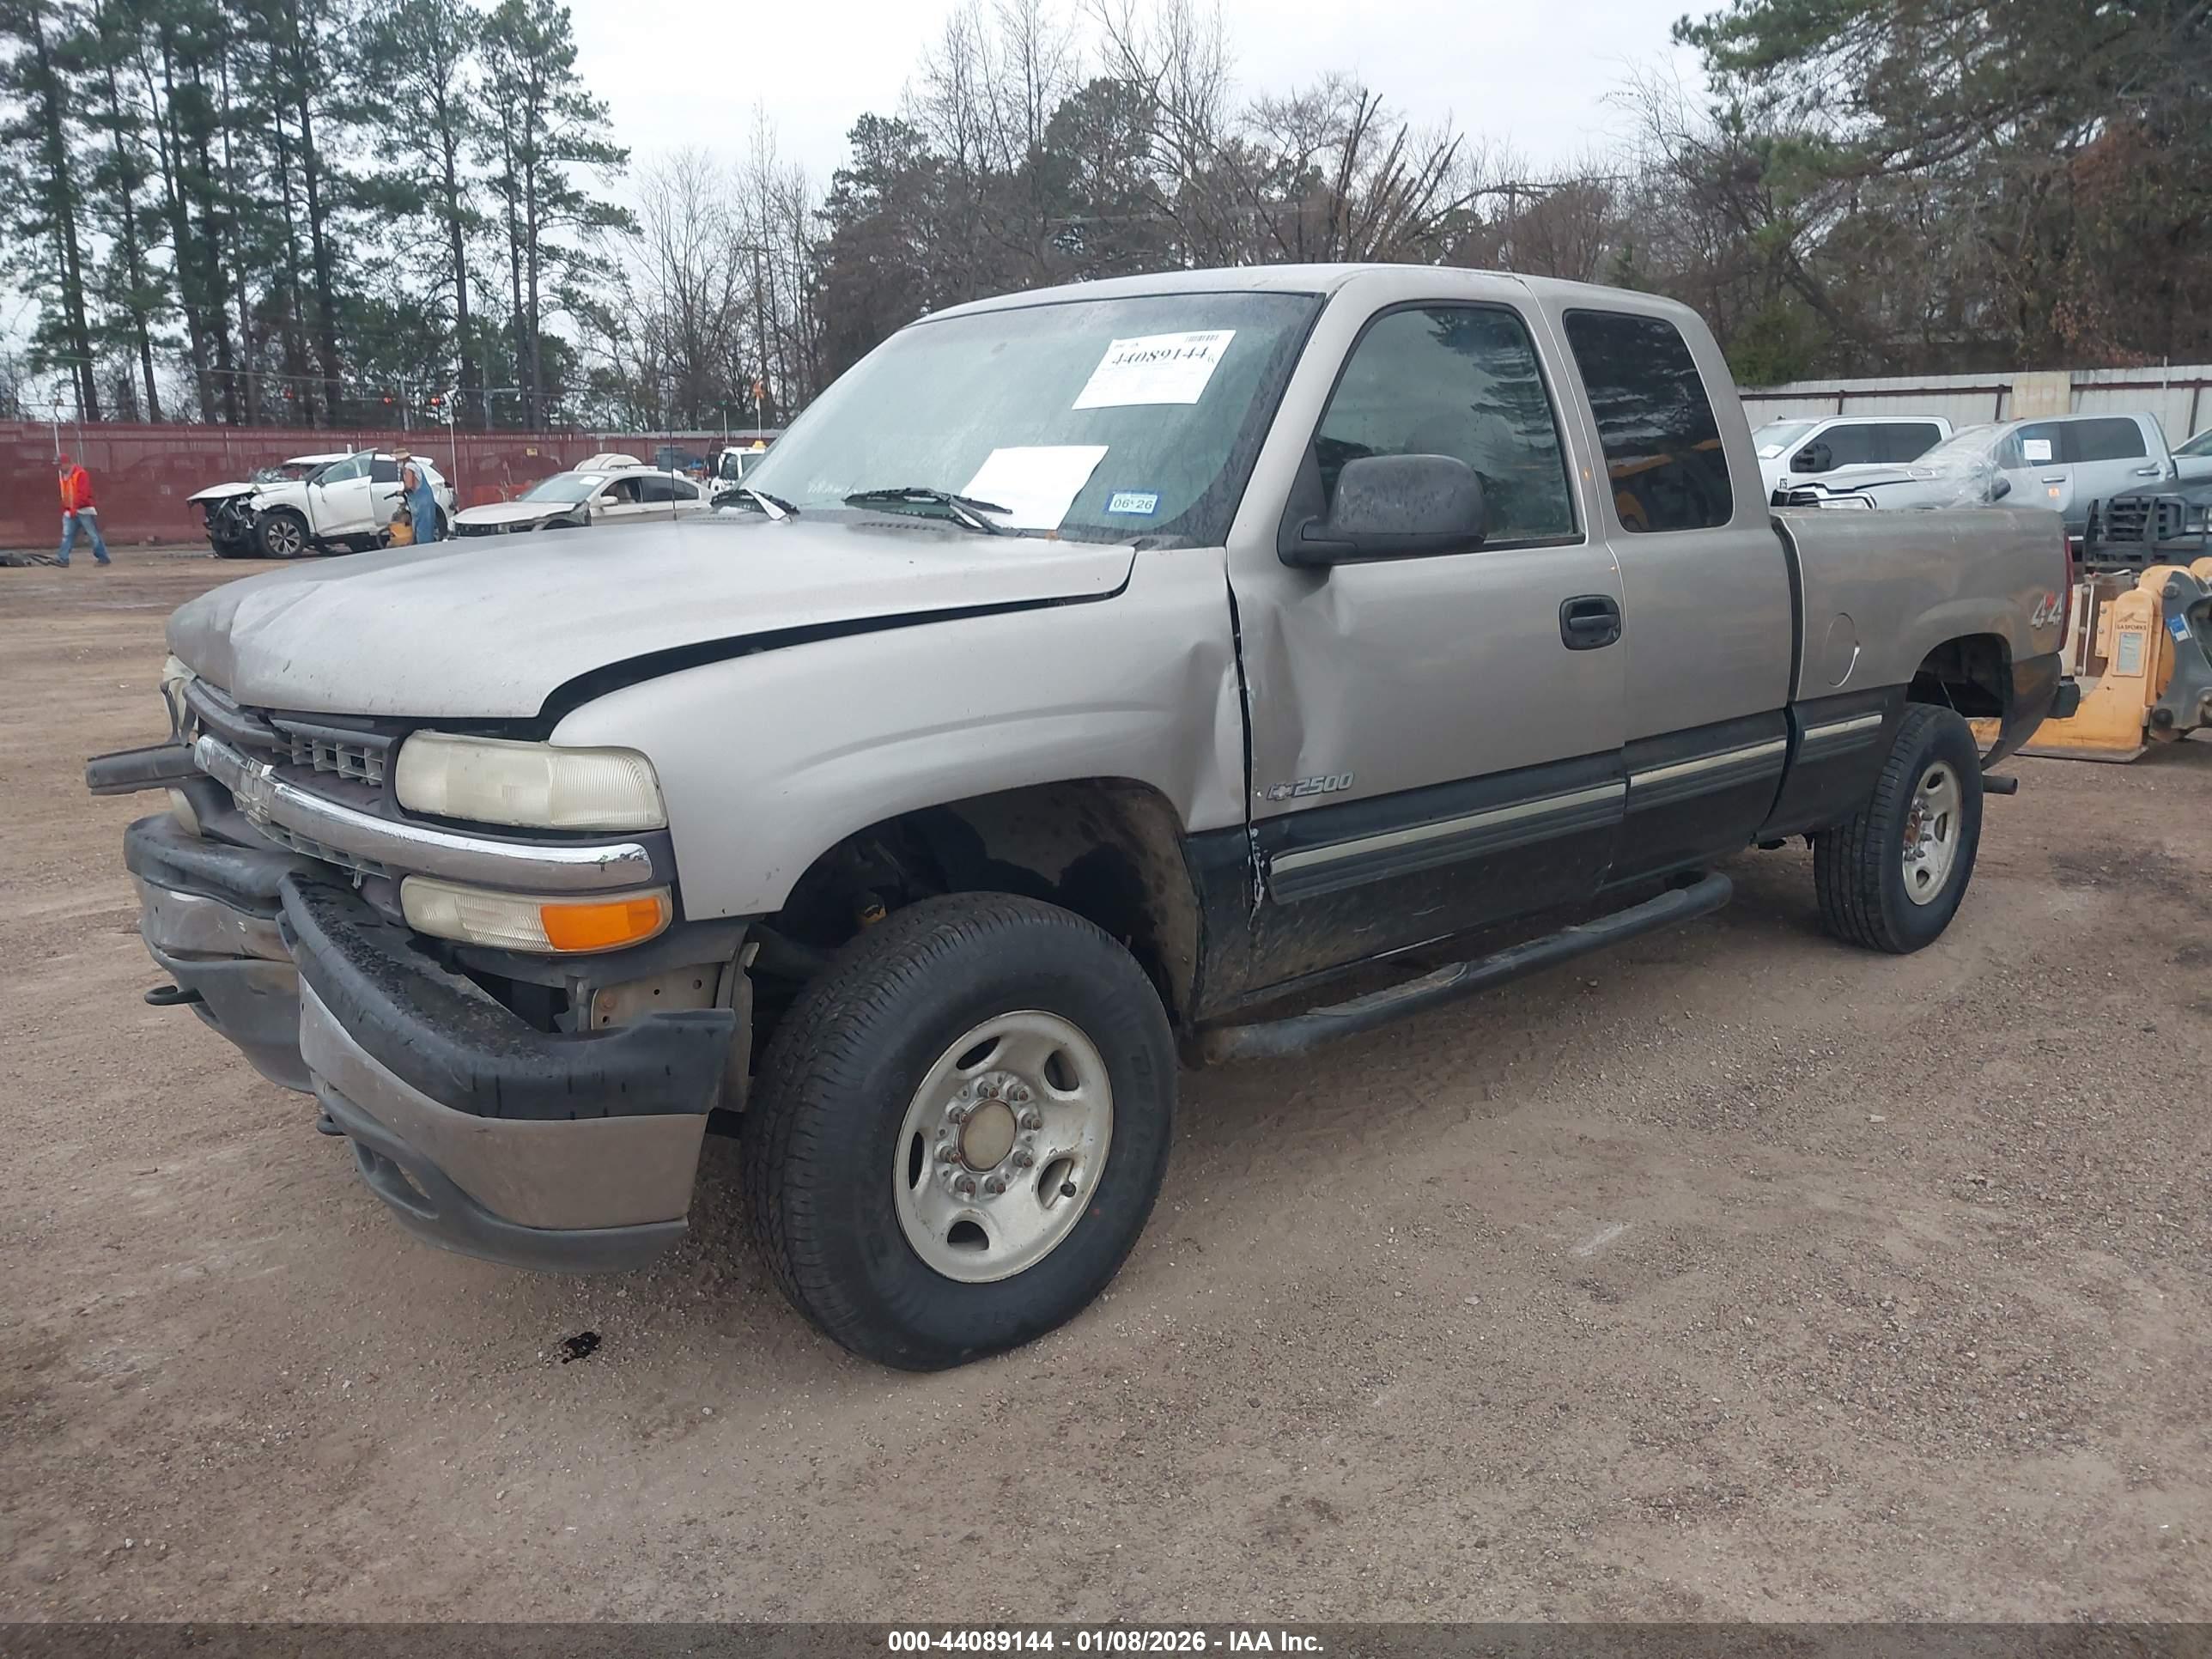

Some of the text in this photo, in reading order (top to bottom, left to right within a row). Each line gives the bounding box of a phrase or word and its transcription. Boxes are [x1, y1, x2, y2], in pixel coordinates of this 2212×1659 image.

[1111, 346, 1209, 366] 44089144
[1135, 499, 1153, 510] 26
[1292, 771, 1354, 798] 2500
